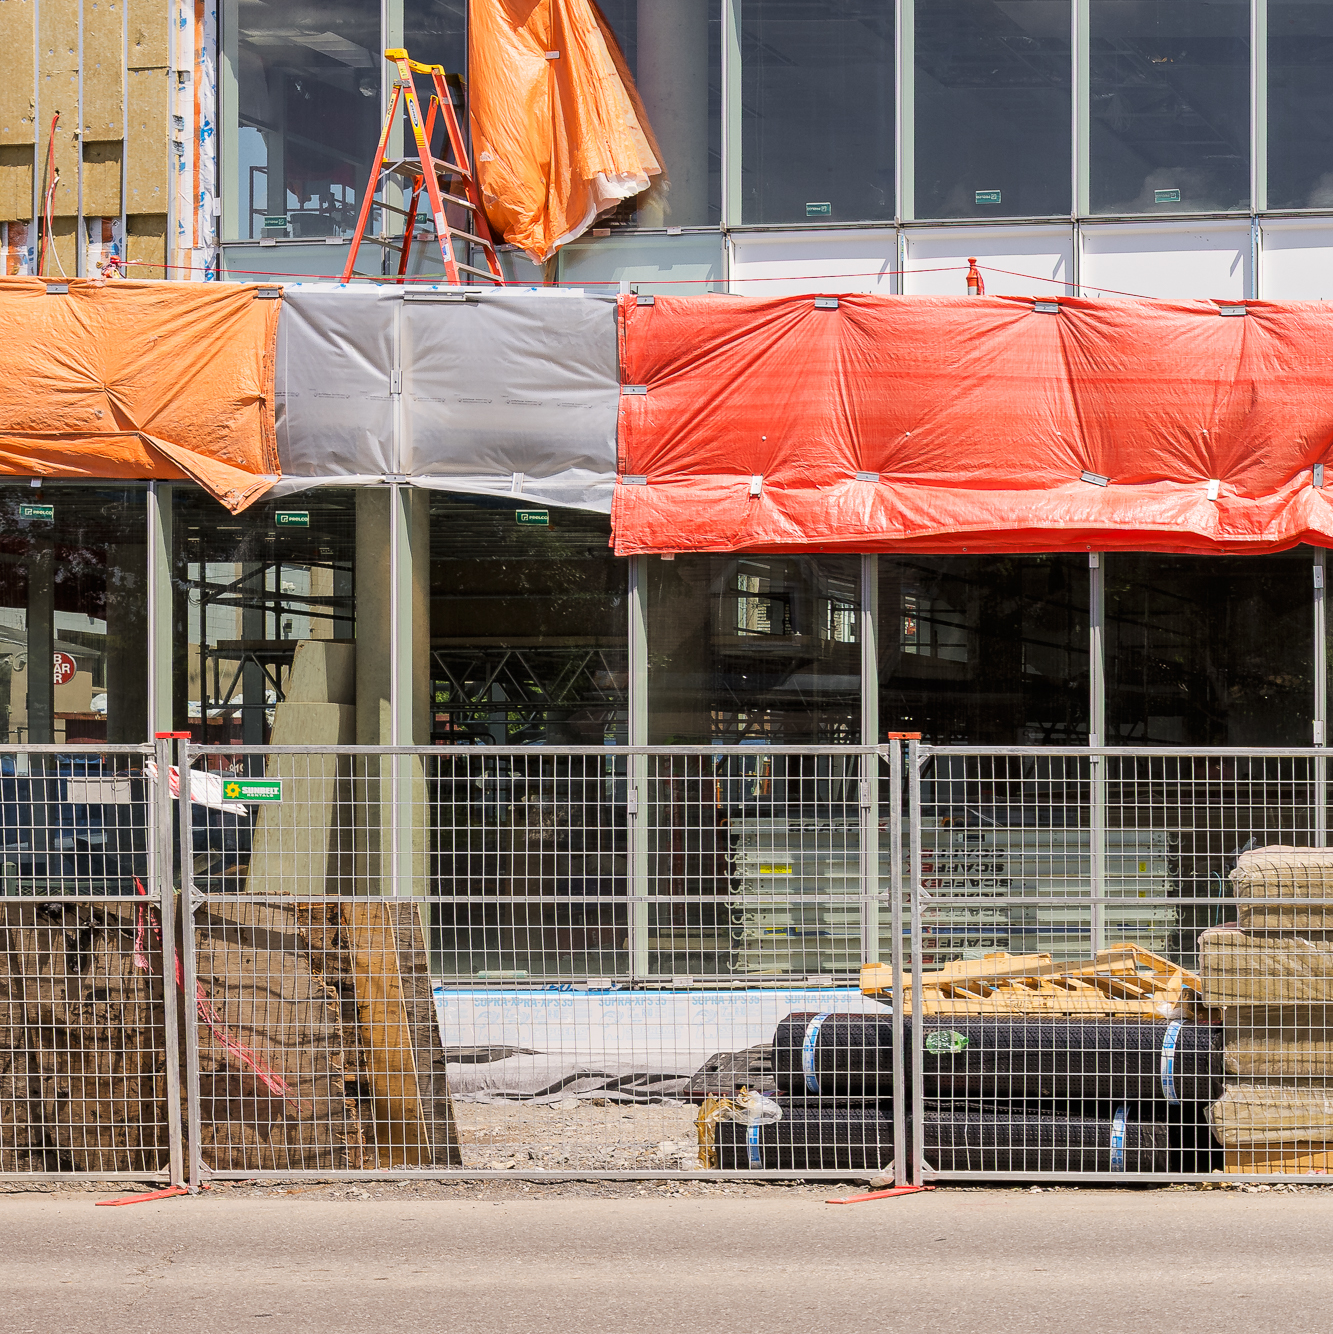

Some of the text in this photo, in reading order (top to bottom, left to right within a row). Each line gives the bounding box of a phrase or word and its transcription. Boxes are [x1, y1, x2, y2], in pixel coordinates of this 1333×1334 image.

[561, 997, 573, 1008] 35
[655, 996, 667, 1006] 35
[748, 994, 760, 1005] 35
[841, 993, 852, 1004] 35
